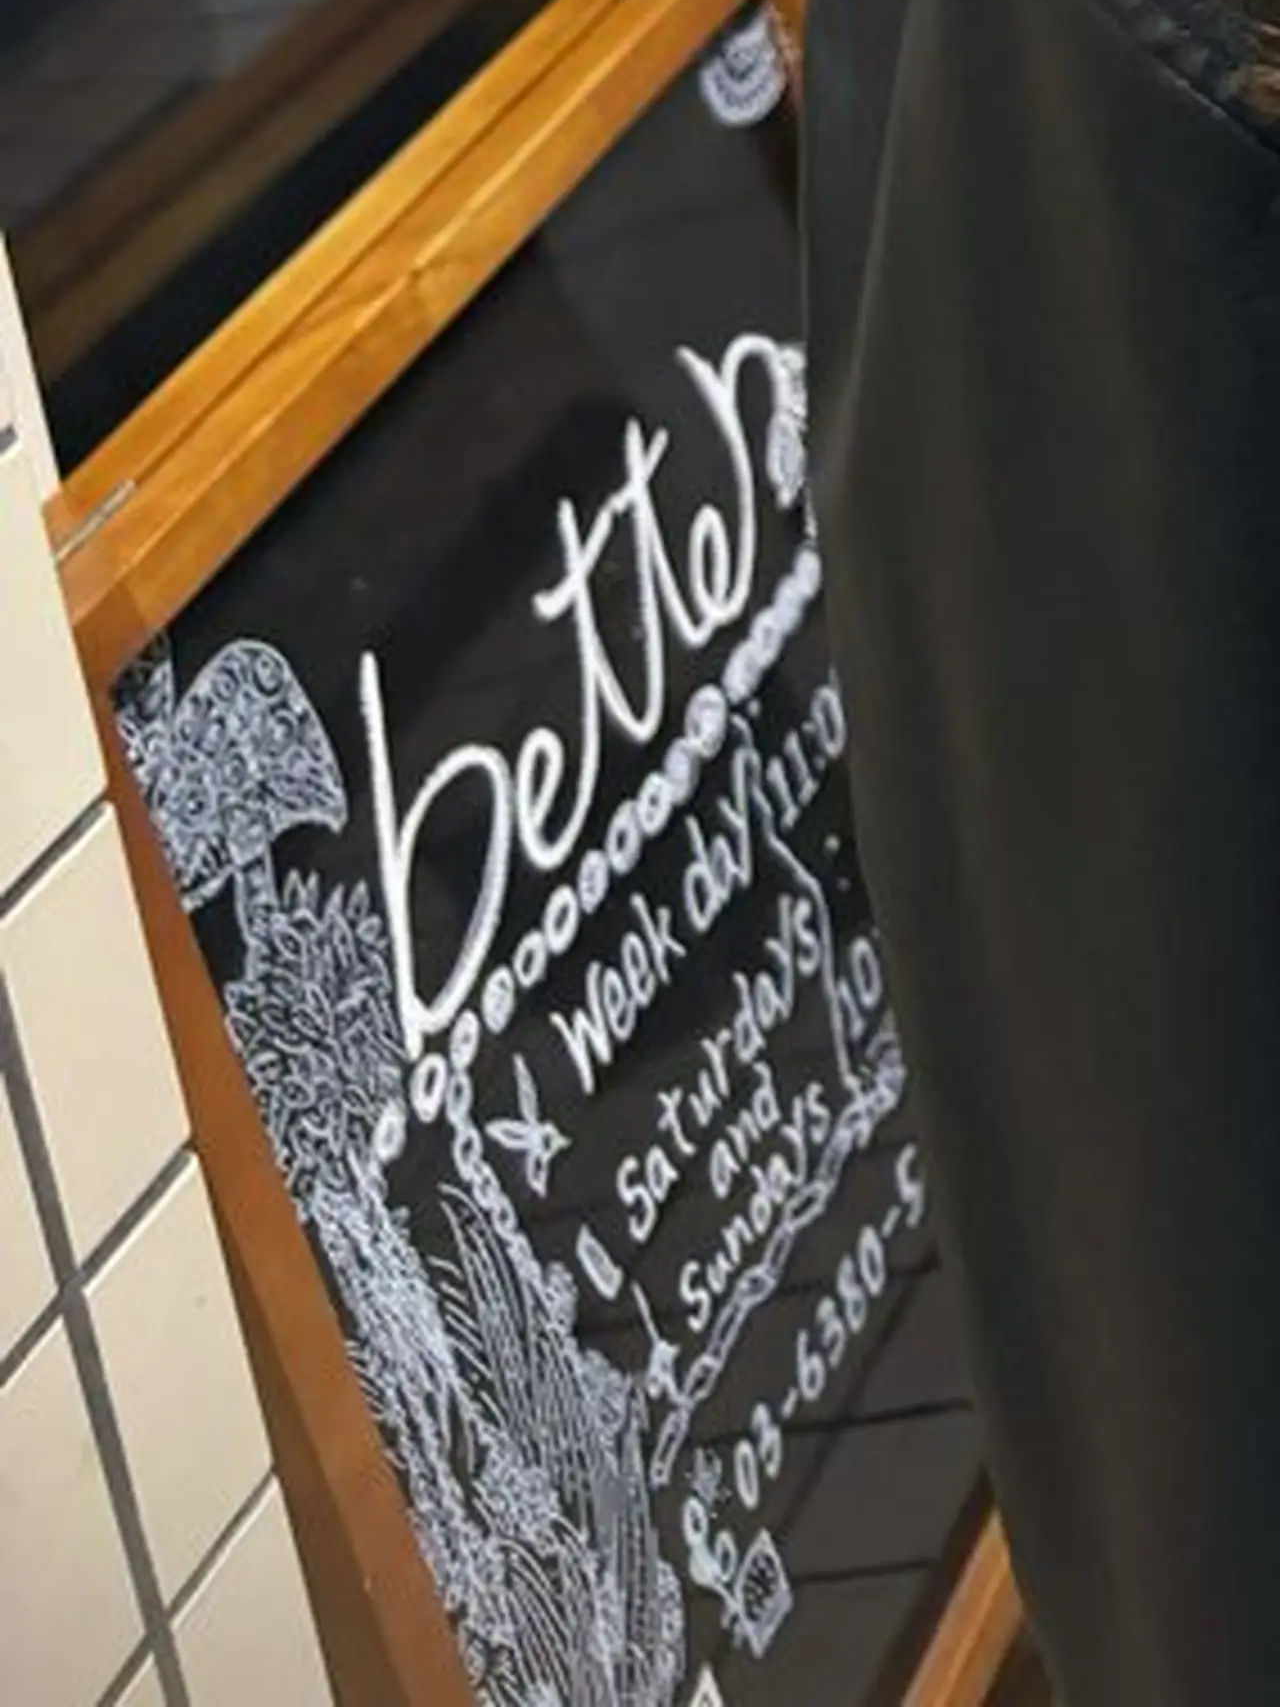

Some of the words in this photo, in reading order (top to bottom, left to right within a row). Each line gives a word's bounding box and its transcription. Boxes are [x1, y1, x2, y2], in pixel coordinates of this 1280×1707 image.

[361, 333, 802, 1062] better
[550, 893, 686, 1094] Week
[767, 666, 847, 832] 11:0
[617, 893, 820, 1242] Saturdays
[680, 1081, 830, 1332] Sundays
[710, 1061, 780, 1199] and
